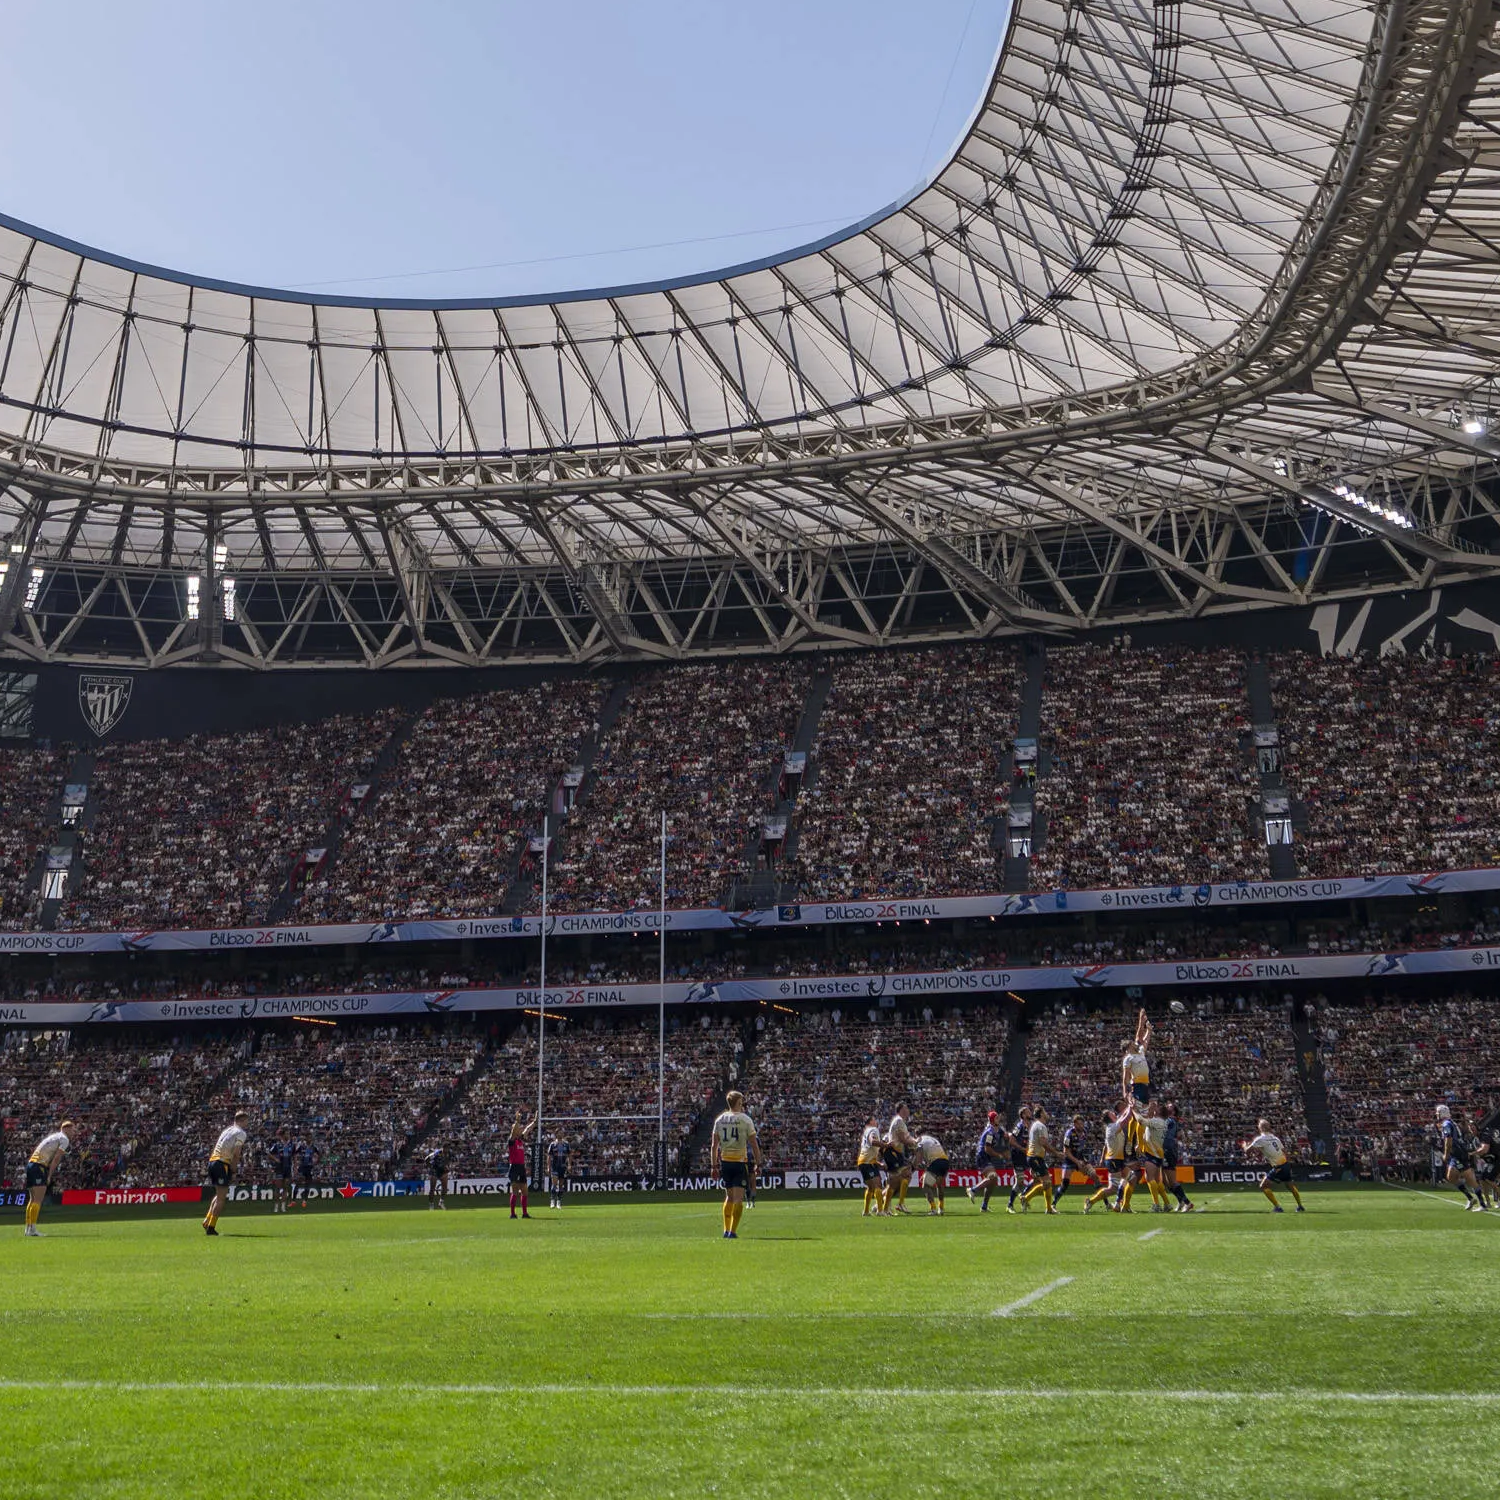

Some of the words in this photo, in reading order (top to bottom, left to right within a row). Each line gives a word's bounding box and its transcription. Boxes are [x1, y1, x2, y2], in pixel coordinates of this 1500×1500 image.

[1218, 884, 1308, 901] CHAMPIONS
[1311, 882, 1342, 896] CUP
[825, 906, 874, 920] Bilbao
[876, 904, 897, 918] 26
[900, 903, 940, 917] FINAL
[469, 920, 531, 935] Investc
[561, 914, 641, 931] CHAMPIONS
[644, 914, 672, 929] CUP
[55, 936, 84, 949] CUP
[210, 931, 254, 946] Bilbao
[255, 930, 275, 945] 26
[276, 931, 312, 943] FINAL
[1176, 965, 1229, 981] Bilbao
[1231, 963, 1254, 978] 26
[1256, 964, 1300, 977] FINAL
[793, 980, 861, 995] Investec
[892, 974, 978, 991] CHAMPIONS
[981, 973, 1011, 988] CUP
[565, 990, 585, 1004] 26
[587, 990, 626, 1004] FINAL
[173, 1002, 233, 1017] Investec
[262, 999, 339, 1014] CHAMPIONS
[342, 998, 368, 1011] CUP
[722, 1127, 739, 1142] 14
[567, 1177, 633, 1192] Investec
[756, 1176, 782, 1189] CUP
[94, 1190, 168, 1204] Emirates
